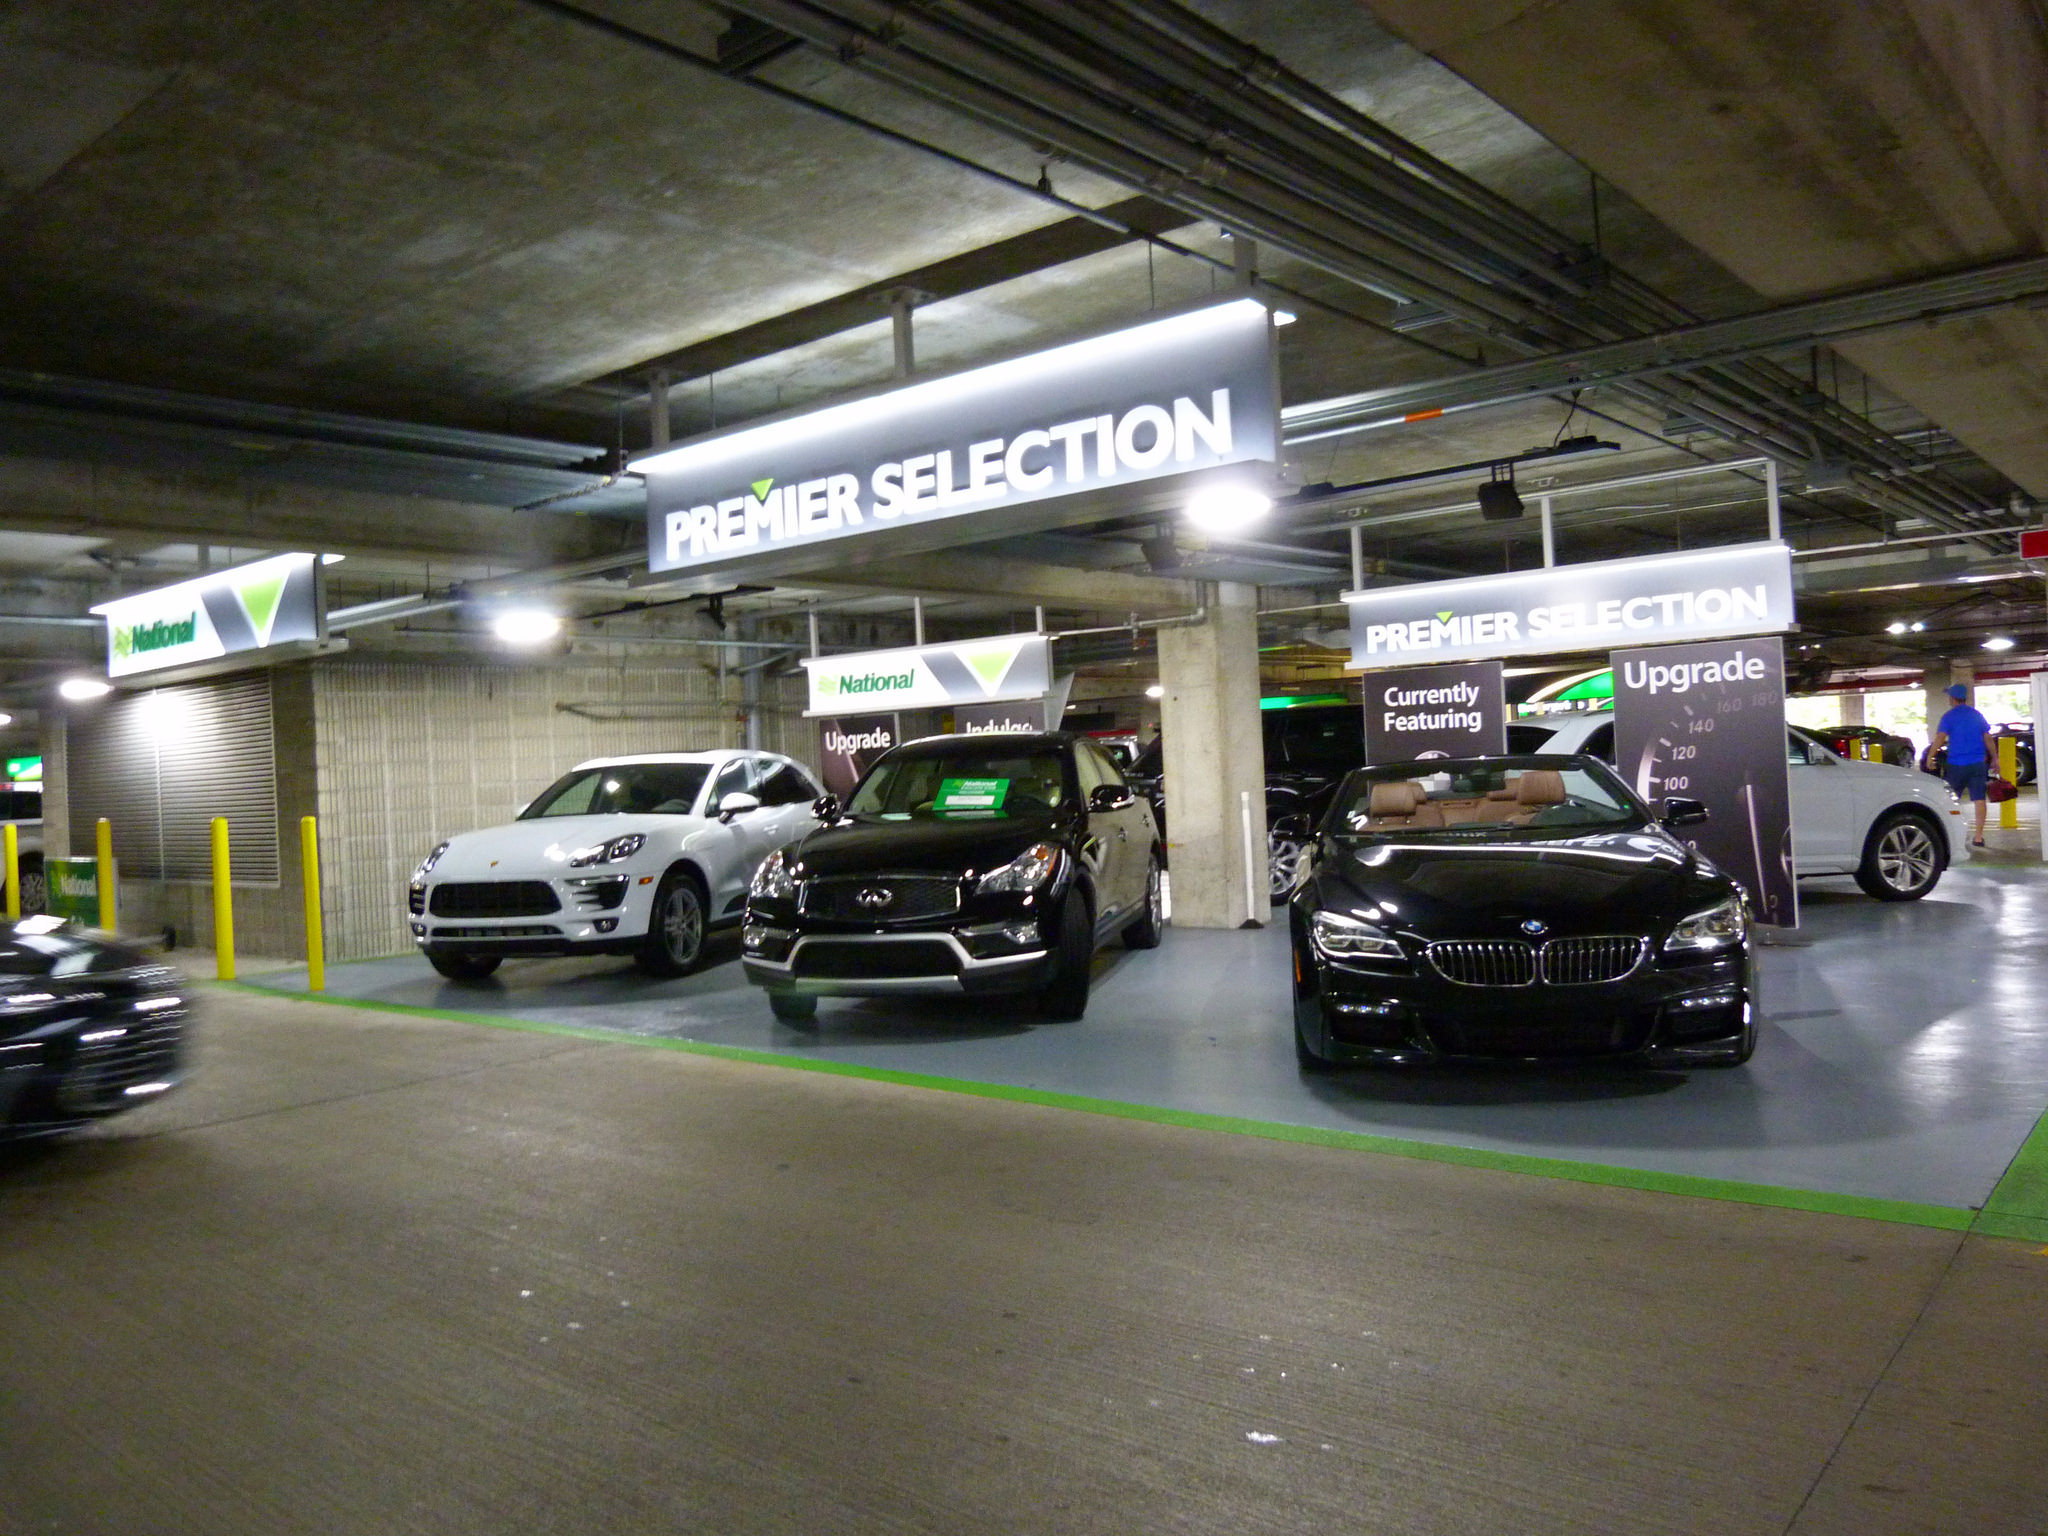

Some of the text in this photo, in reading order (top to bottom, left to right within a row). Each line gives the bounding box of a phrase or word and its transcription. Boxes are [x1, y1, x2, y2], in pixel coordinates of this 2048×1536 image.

[666, 388, 1233, 562] PREMIER SELECTION
[132, 610, 196, 655] National
[1367, 585, 1767, 654] PREMIER SELECTION
[839, 668, 914, 695] National
[1624, 651, 1766, 694] Upgrade
[1384, 681, 1479, 707] Currently
[1384, 708, 1482, 733] Featuring
[1688, 718, 1714, 734] 140
[825, 726, 891, 755] Upgrade
[1672, 745, 1696, 760] 120
[1663, 776, 1688, 791] 100
